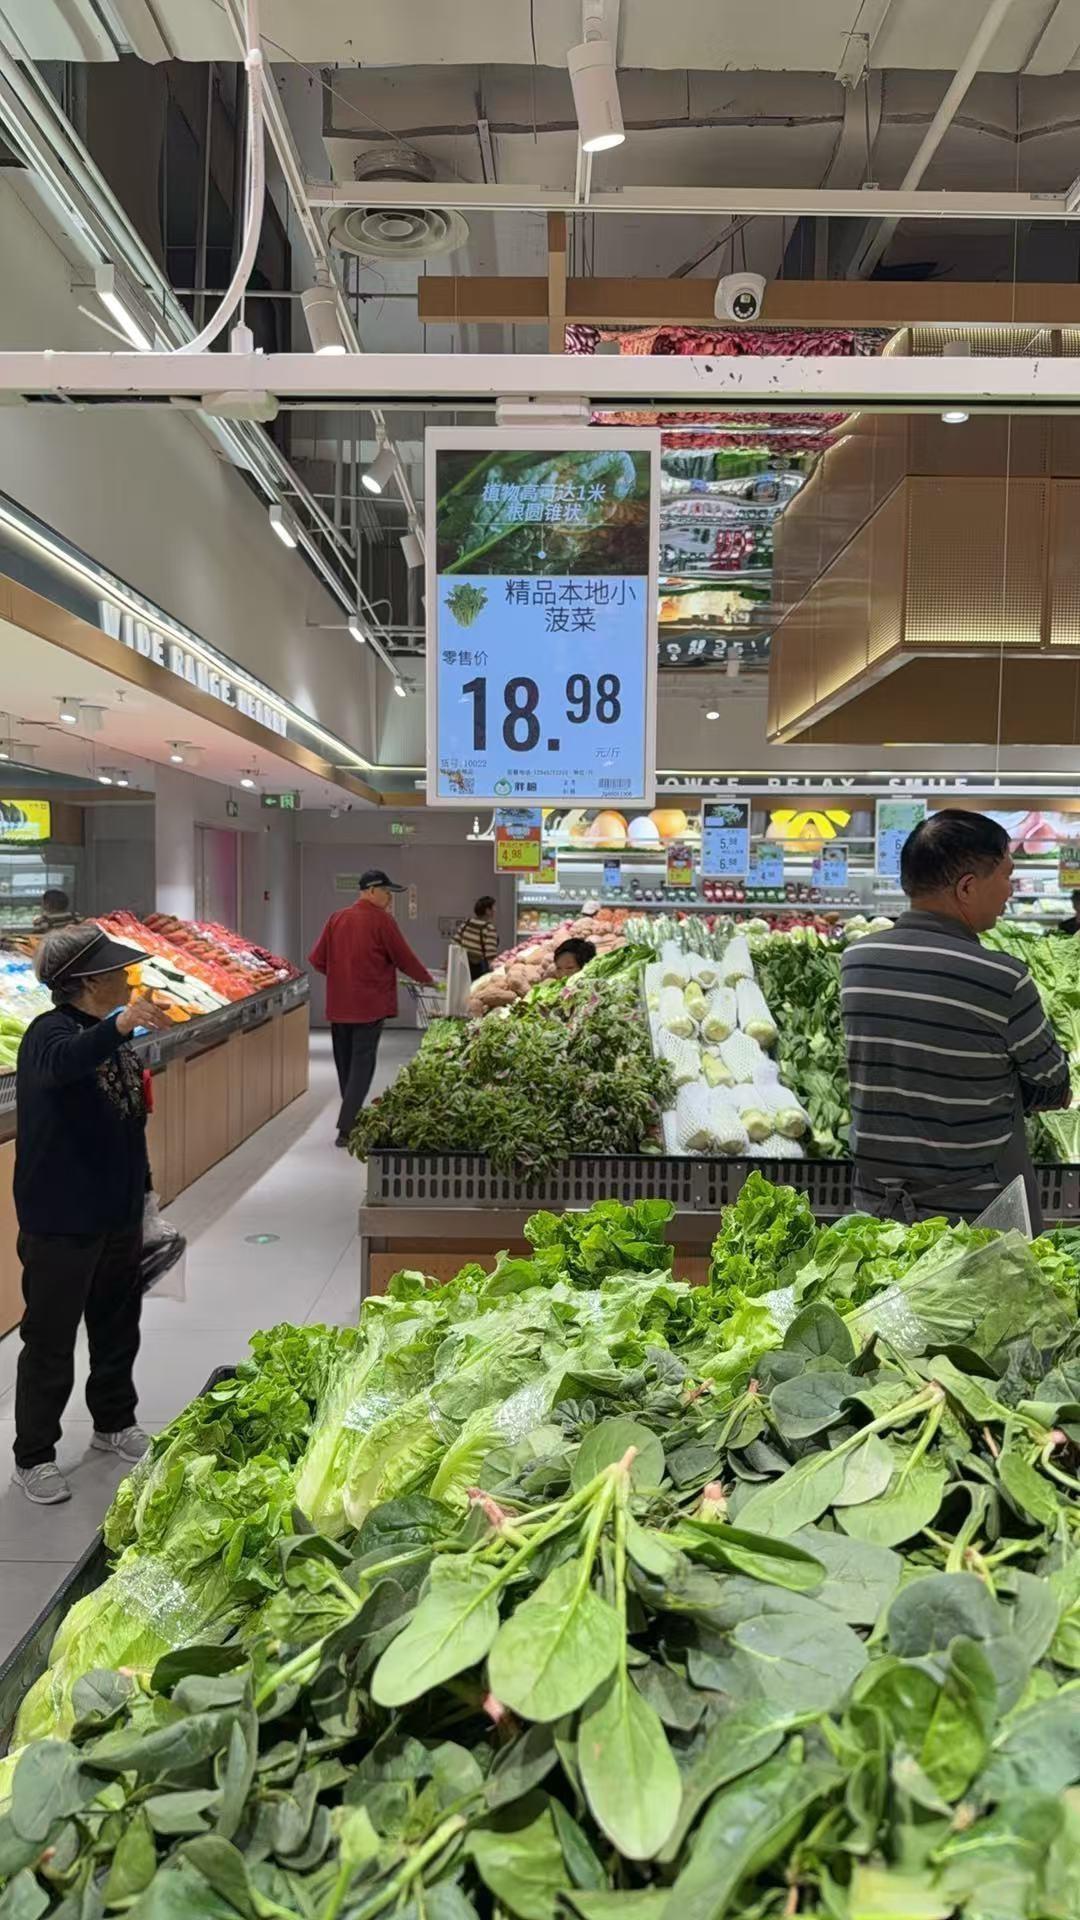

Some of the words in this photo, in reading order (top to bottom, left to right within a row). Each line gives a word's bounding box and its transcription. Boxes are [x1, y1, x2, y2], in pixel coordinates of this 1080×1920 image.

[482, 483, 606, 502] 植物高可达1米
[505, 579, 637, 606] 精品本地小
[545, 606, 597, 633] 菠菜
[102, 600, 165, 667] WIDE
[442, 650, 489, 666] 零售价
[462, 673, 621, 752] 18.98
